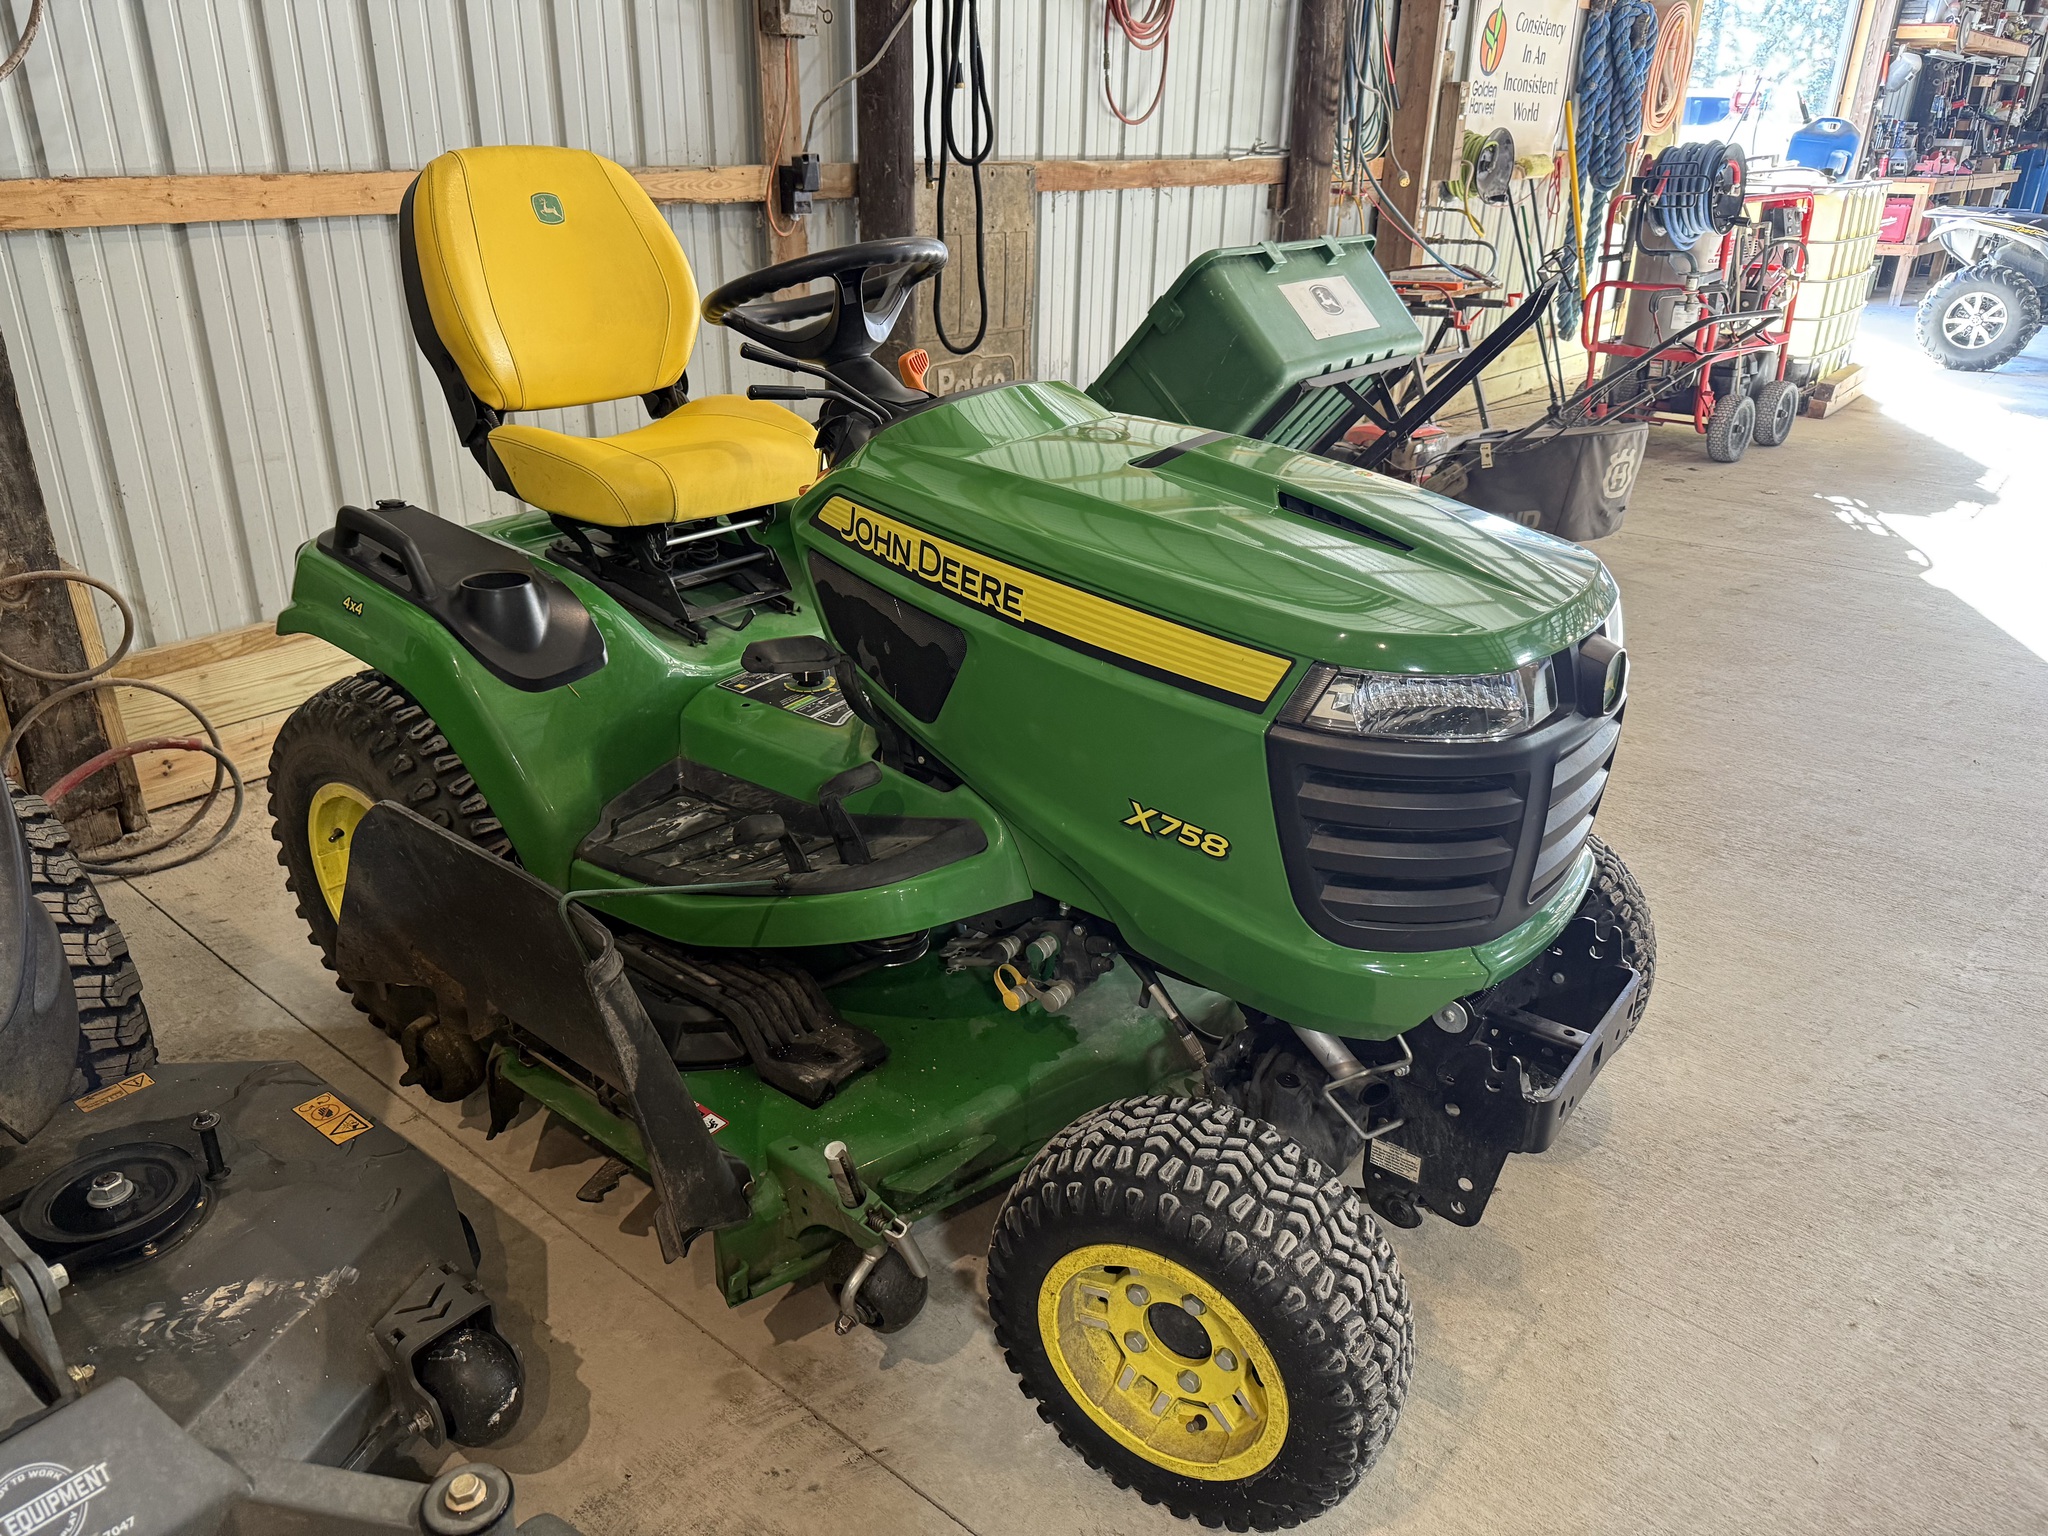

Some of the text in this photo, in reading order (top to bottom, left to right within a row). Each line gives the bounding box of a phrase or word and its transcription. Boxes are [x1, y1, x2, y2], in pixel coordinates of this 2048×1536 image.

[1515, 12, 1566, 44] Consistency
[1522, 44, 1547, 65] In An
[1471, 80, 1498, 98] Golden
[1503, 72, 1558, 95] Inconsistent
[1468, 98, 1496, 115] Harvest
[1513, 102, 1540, 122] World
[840, 506, 1025, 618] JOHN DEERE
[342, 596, 364, 616] 4x4
[1120, 798, 1231, 860] X758
[10, 1474, 25, 1486] TO
[28, 1469, 63, 1481] WORK
[4, 1462, 111, 1536] EQUIPMENT
